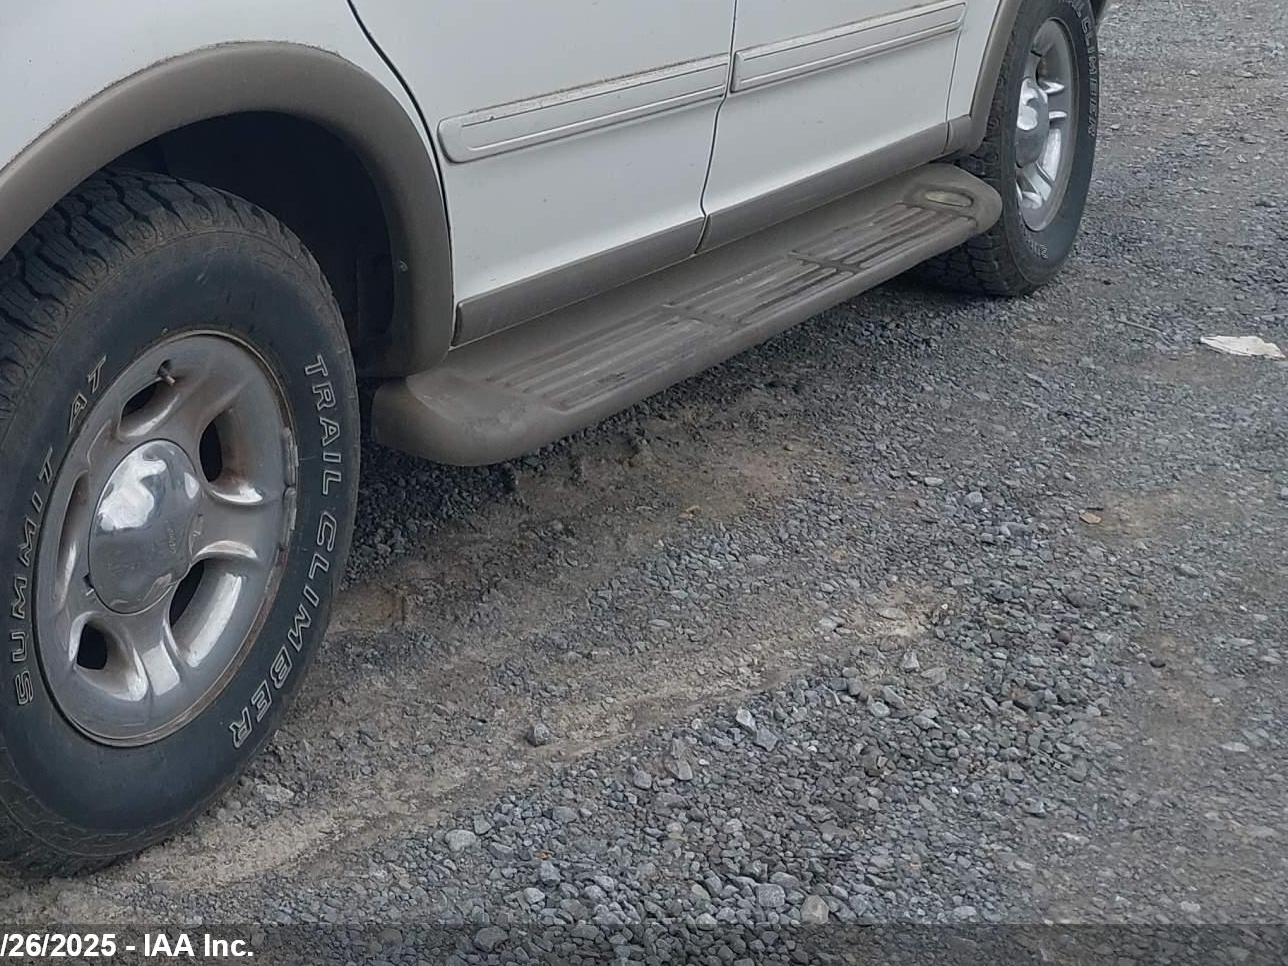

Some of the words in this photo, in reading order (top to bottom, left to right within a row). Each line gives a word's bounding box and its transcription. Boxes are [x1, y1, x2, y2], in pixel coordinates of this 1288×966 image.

[11, 446, 54, 706] SUMMIT
[68, 354, 107, 435] AT
[305, 354, 342, 496] TRAIL
[228, 510, 338, 749] CLIMBER
